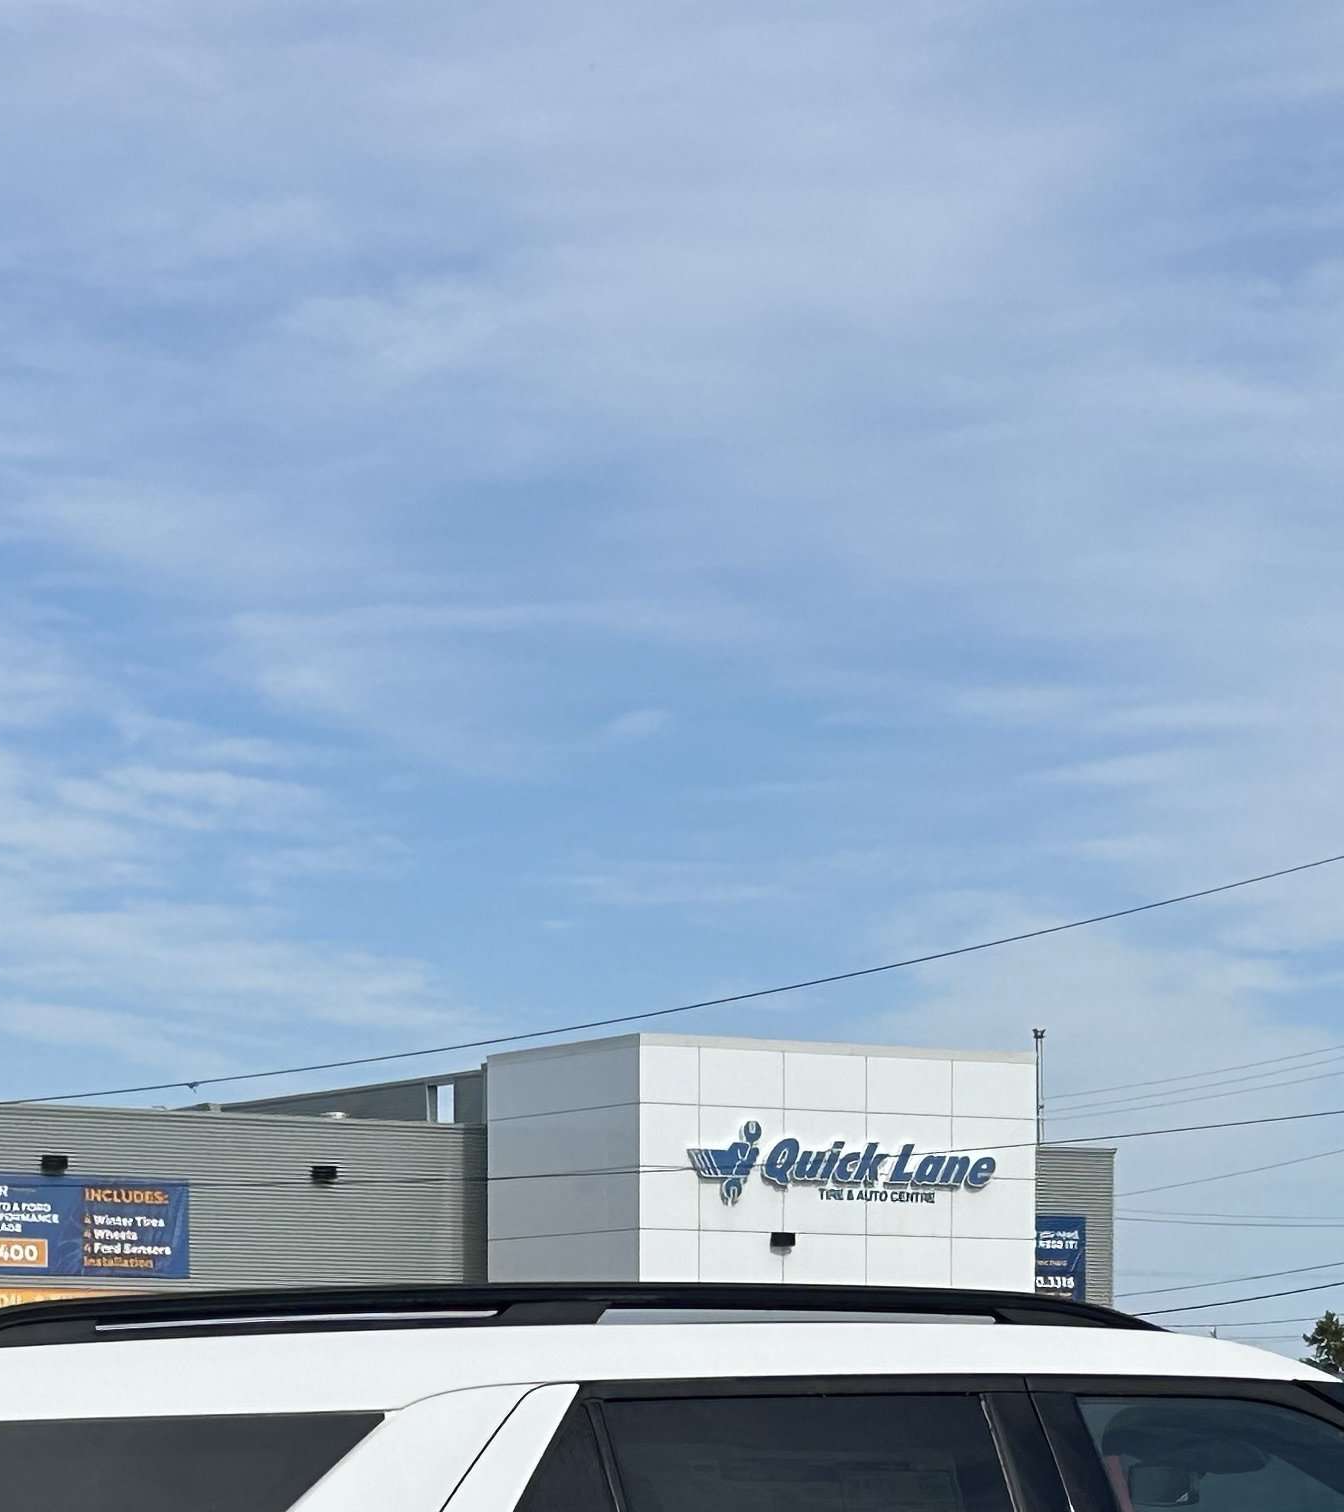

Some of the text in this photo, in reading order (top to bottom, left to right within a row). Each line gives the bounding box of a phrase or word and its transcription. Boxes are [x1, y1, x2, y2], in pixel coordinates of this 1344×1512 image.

[764, 1137, 998, 1188] Quick Lane
[84, 1187, 169, 1204] INCLUDES:
[856, 1190, 888, 1202] AUTO
[890, 1191, 935, 1204] CENTRE
[12, 1202, 21, 1212] A
[93, 1214, 134, 1227] Winter
[135, 1216, 165, 1228] Tires
[93, 1229, 138, 1241] Wheels
[93, 1242, 122, 1255] Ford
